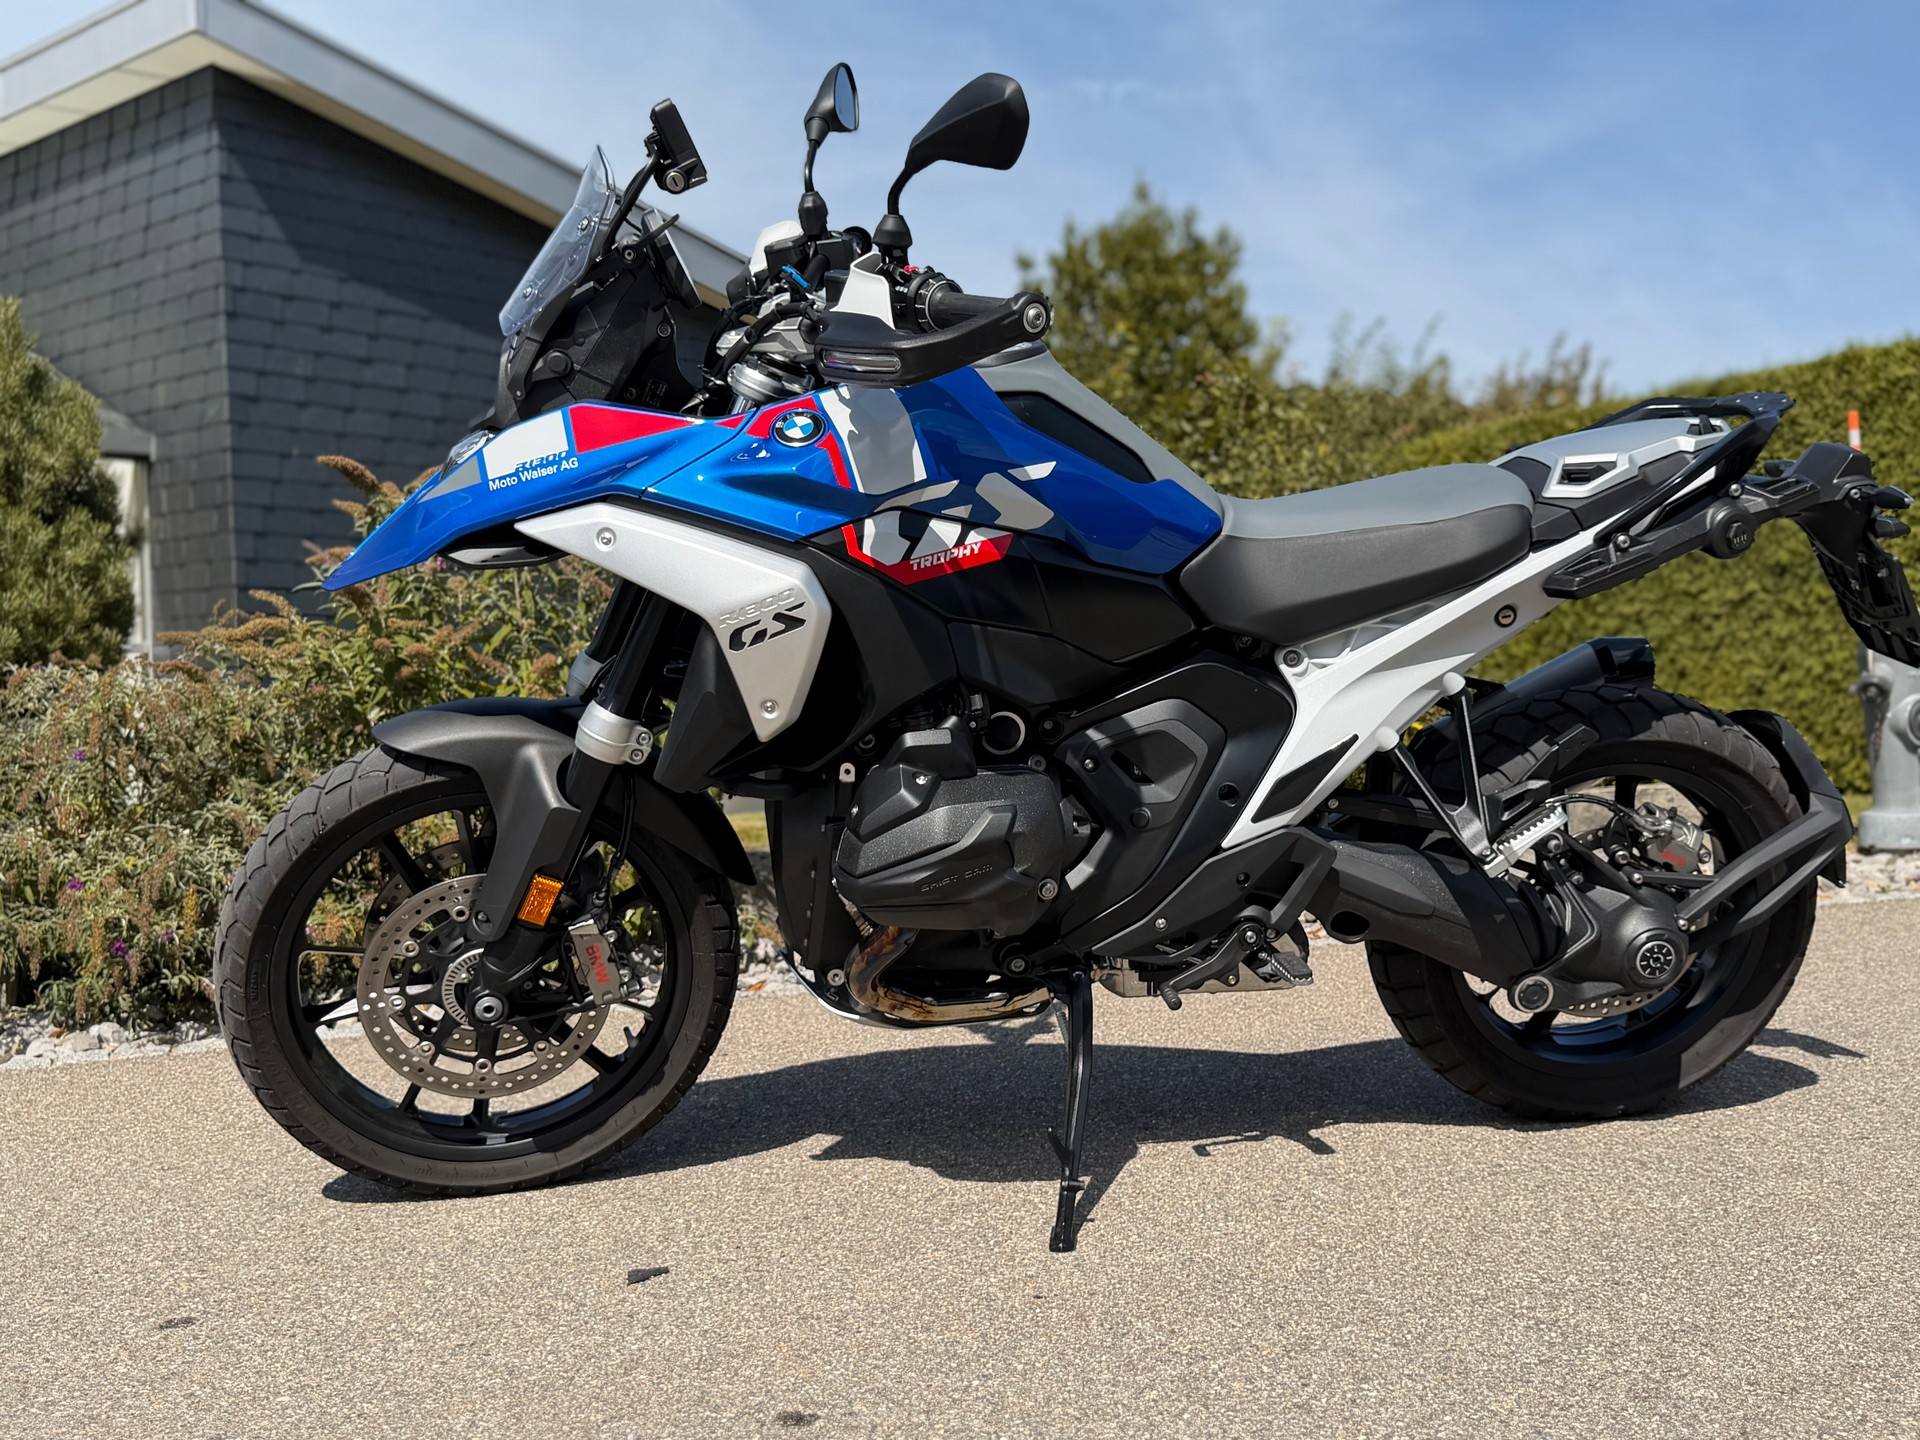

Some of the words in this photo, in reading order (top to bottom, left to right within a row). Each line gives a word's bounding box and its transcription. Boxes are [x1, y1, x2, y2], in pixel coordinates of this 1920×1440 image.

[488, 475, 518, 491] Moto
[519, 464, 559, 483] Walser
[560, 457, 579, 471] AG
[909, 541, 982, 571] TROPHY
[728, 600, 807, 652] GS
[585, 944, 611, 984] BMW
